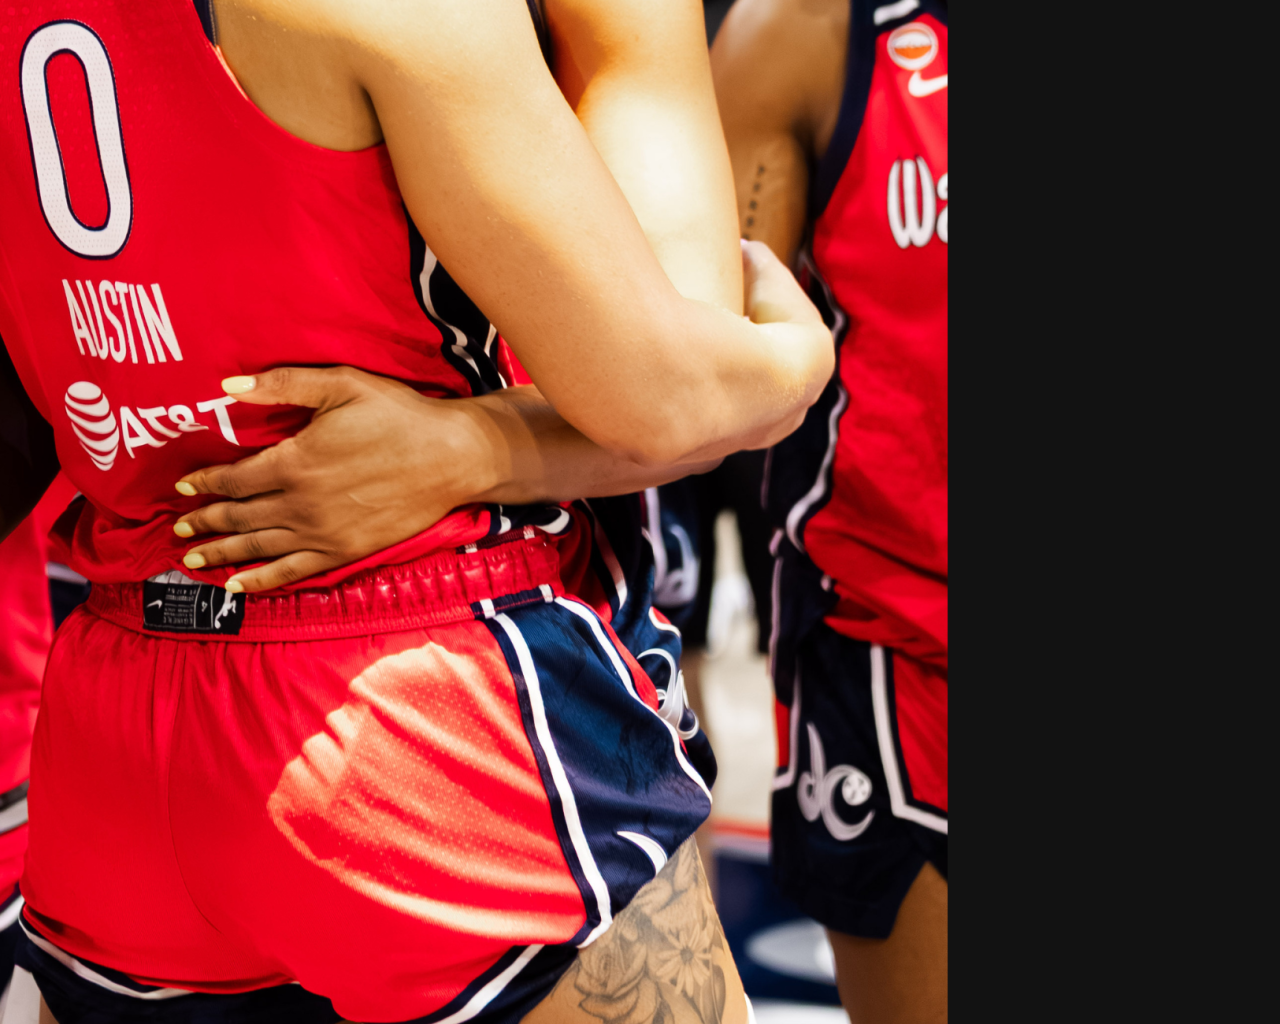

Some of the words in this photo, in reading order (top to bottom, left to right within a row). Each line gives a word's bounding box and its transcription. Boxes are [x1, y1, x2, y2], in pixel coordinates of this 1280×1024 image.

[21, 19, 133, 260] 0
[62, 279, 184, 364] AUSTIN
[120, 395, 238, 459] AT&T
